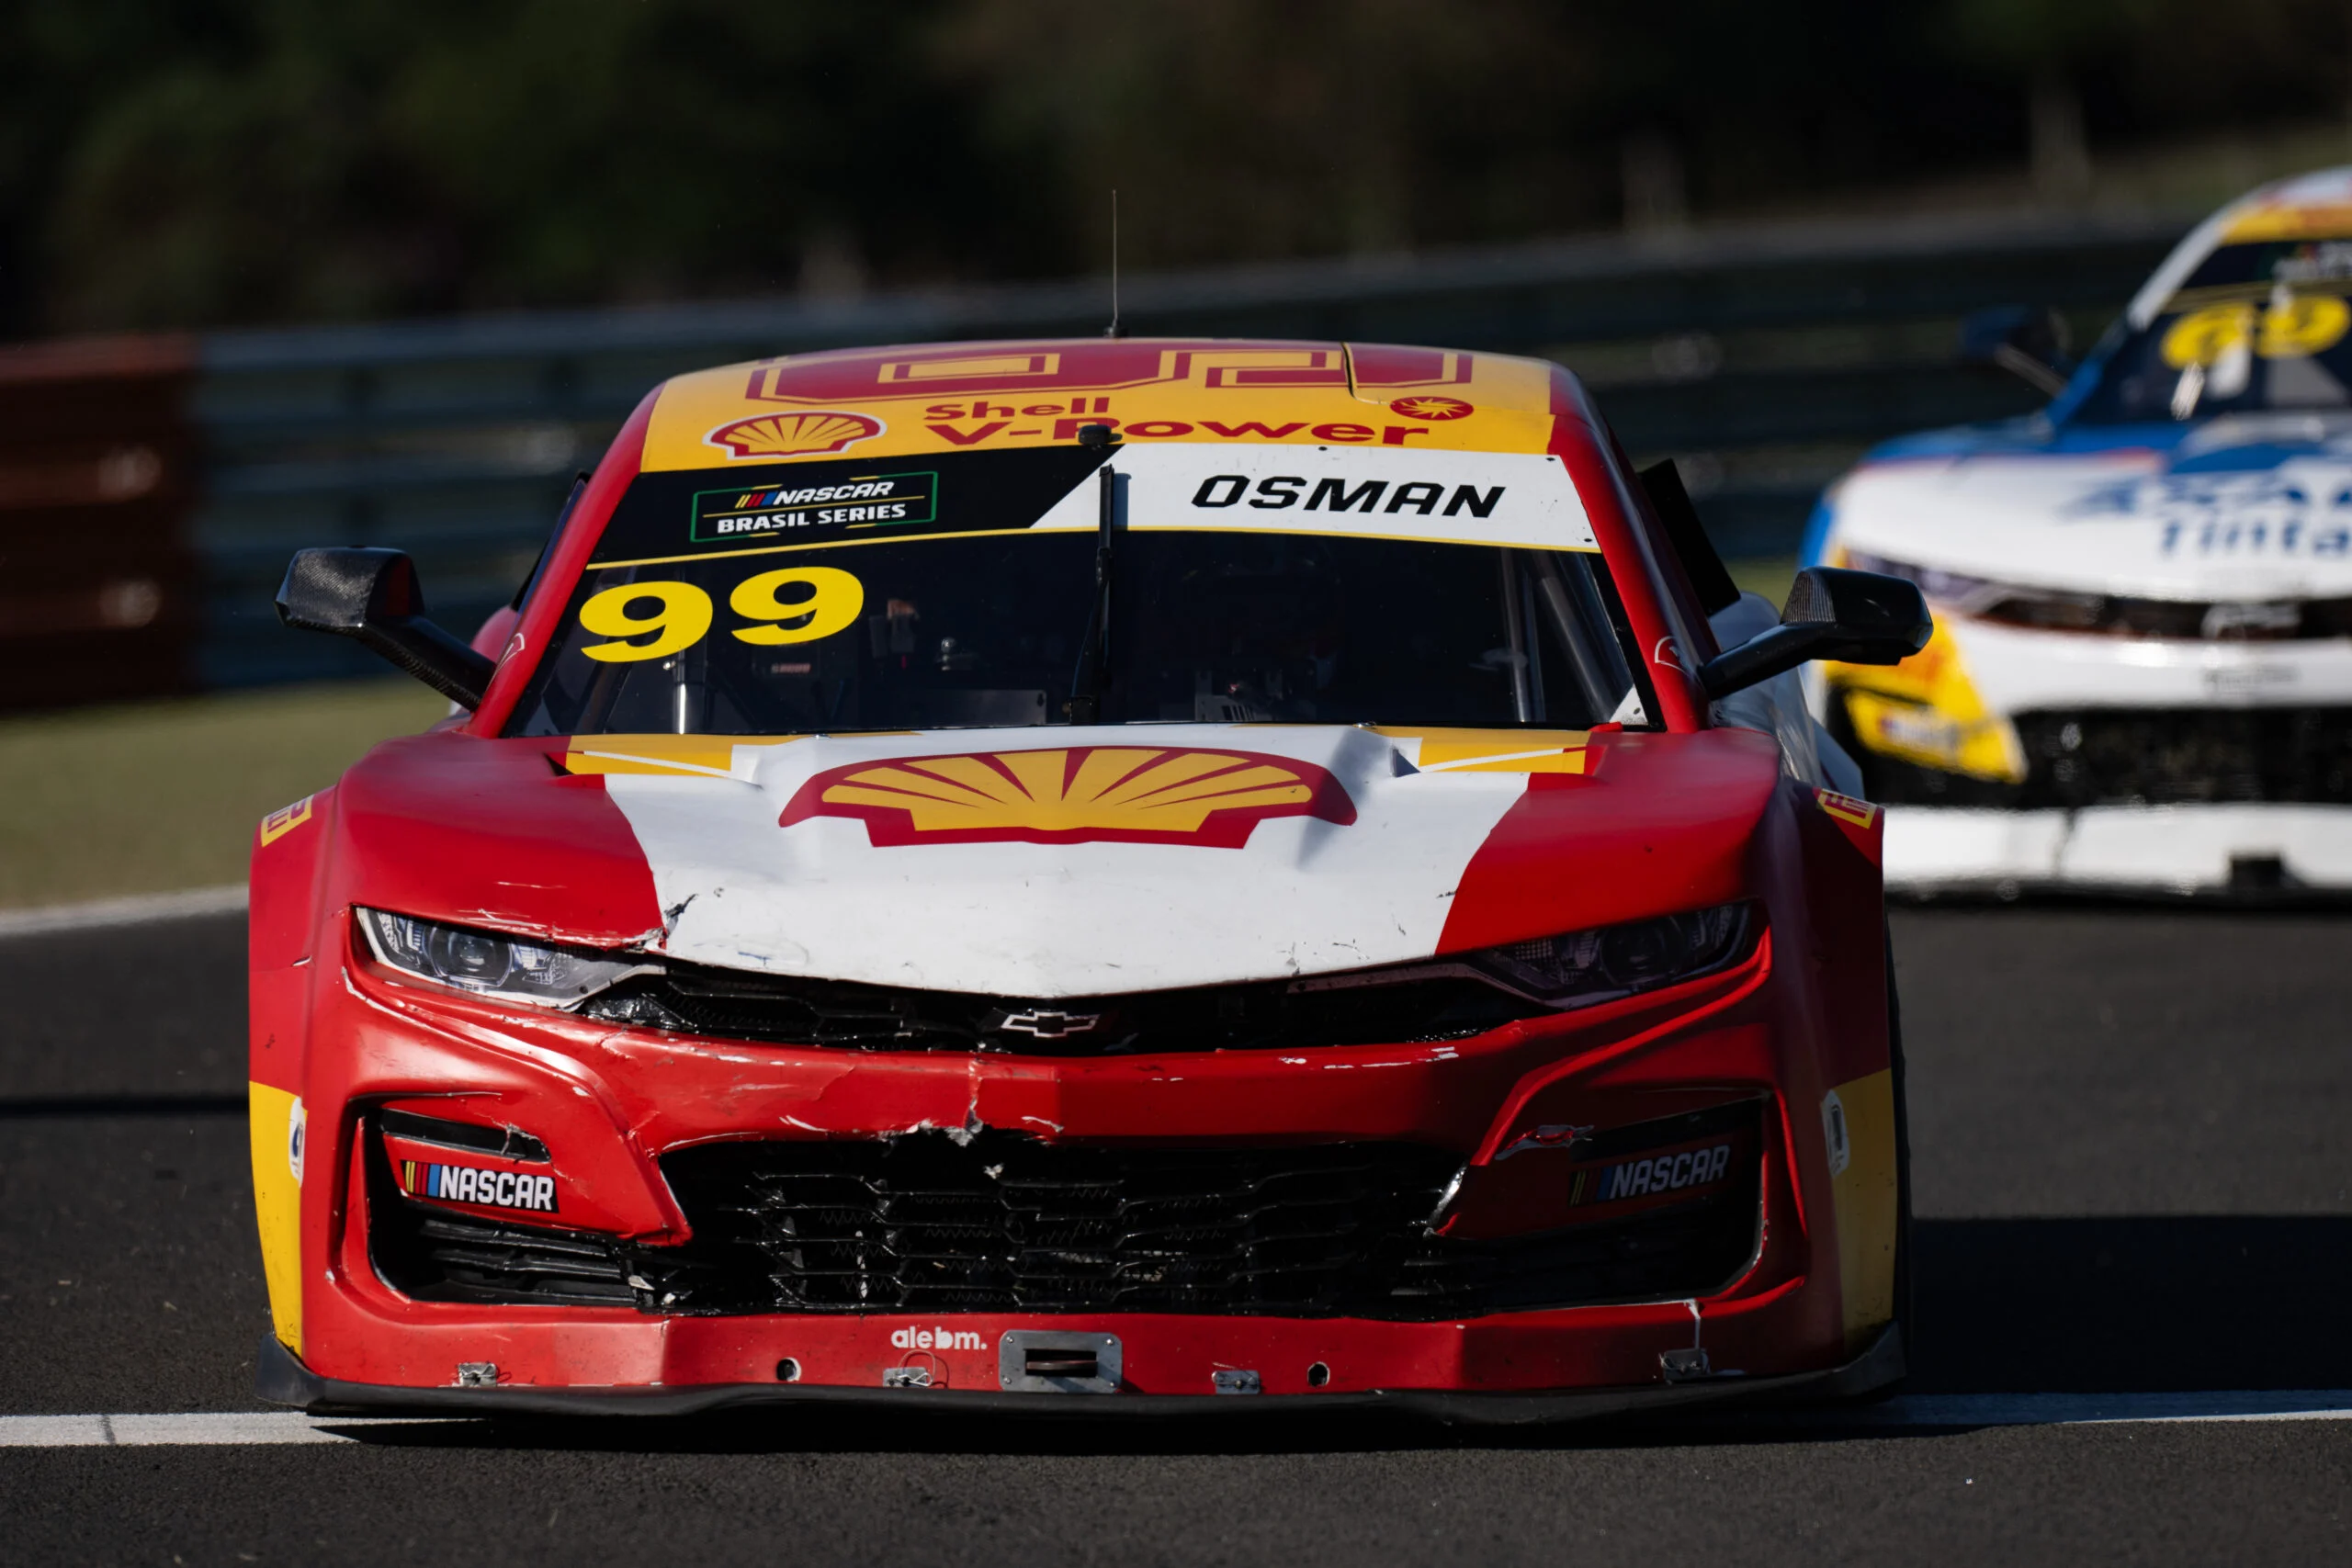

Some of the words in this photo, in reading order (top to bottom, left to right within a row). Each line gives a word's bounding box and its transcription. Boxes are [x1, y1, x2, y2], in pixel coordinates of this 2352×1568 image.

[923, 397, 1110, 421] Shell
[924, 417, 1429, 447] V-Power
[773, 481, 895, 505] NASCAR
[1191, 474, 1506, 518] OSMAN
[718, 512, 810, 534] BRASIL
[818, 503, 907, 525] SERIES
[579, 566, 865, 663] 99
[439, 1165, 554, 1212] NASCAR
[1609, 1145, 1731, 1200] NASCAR
